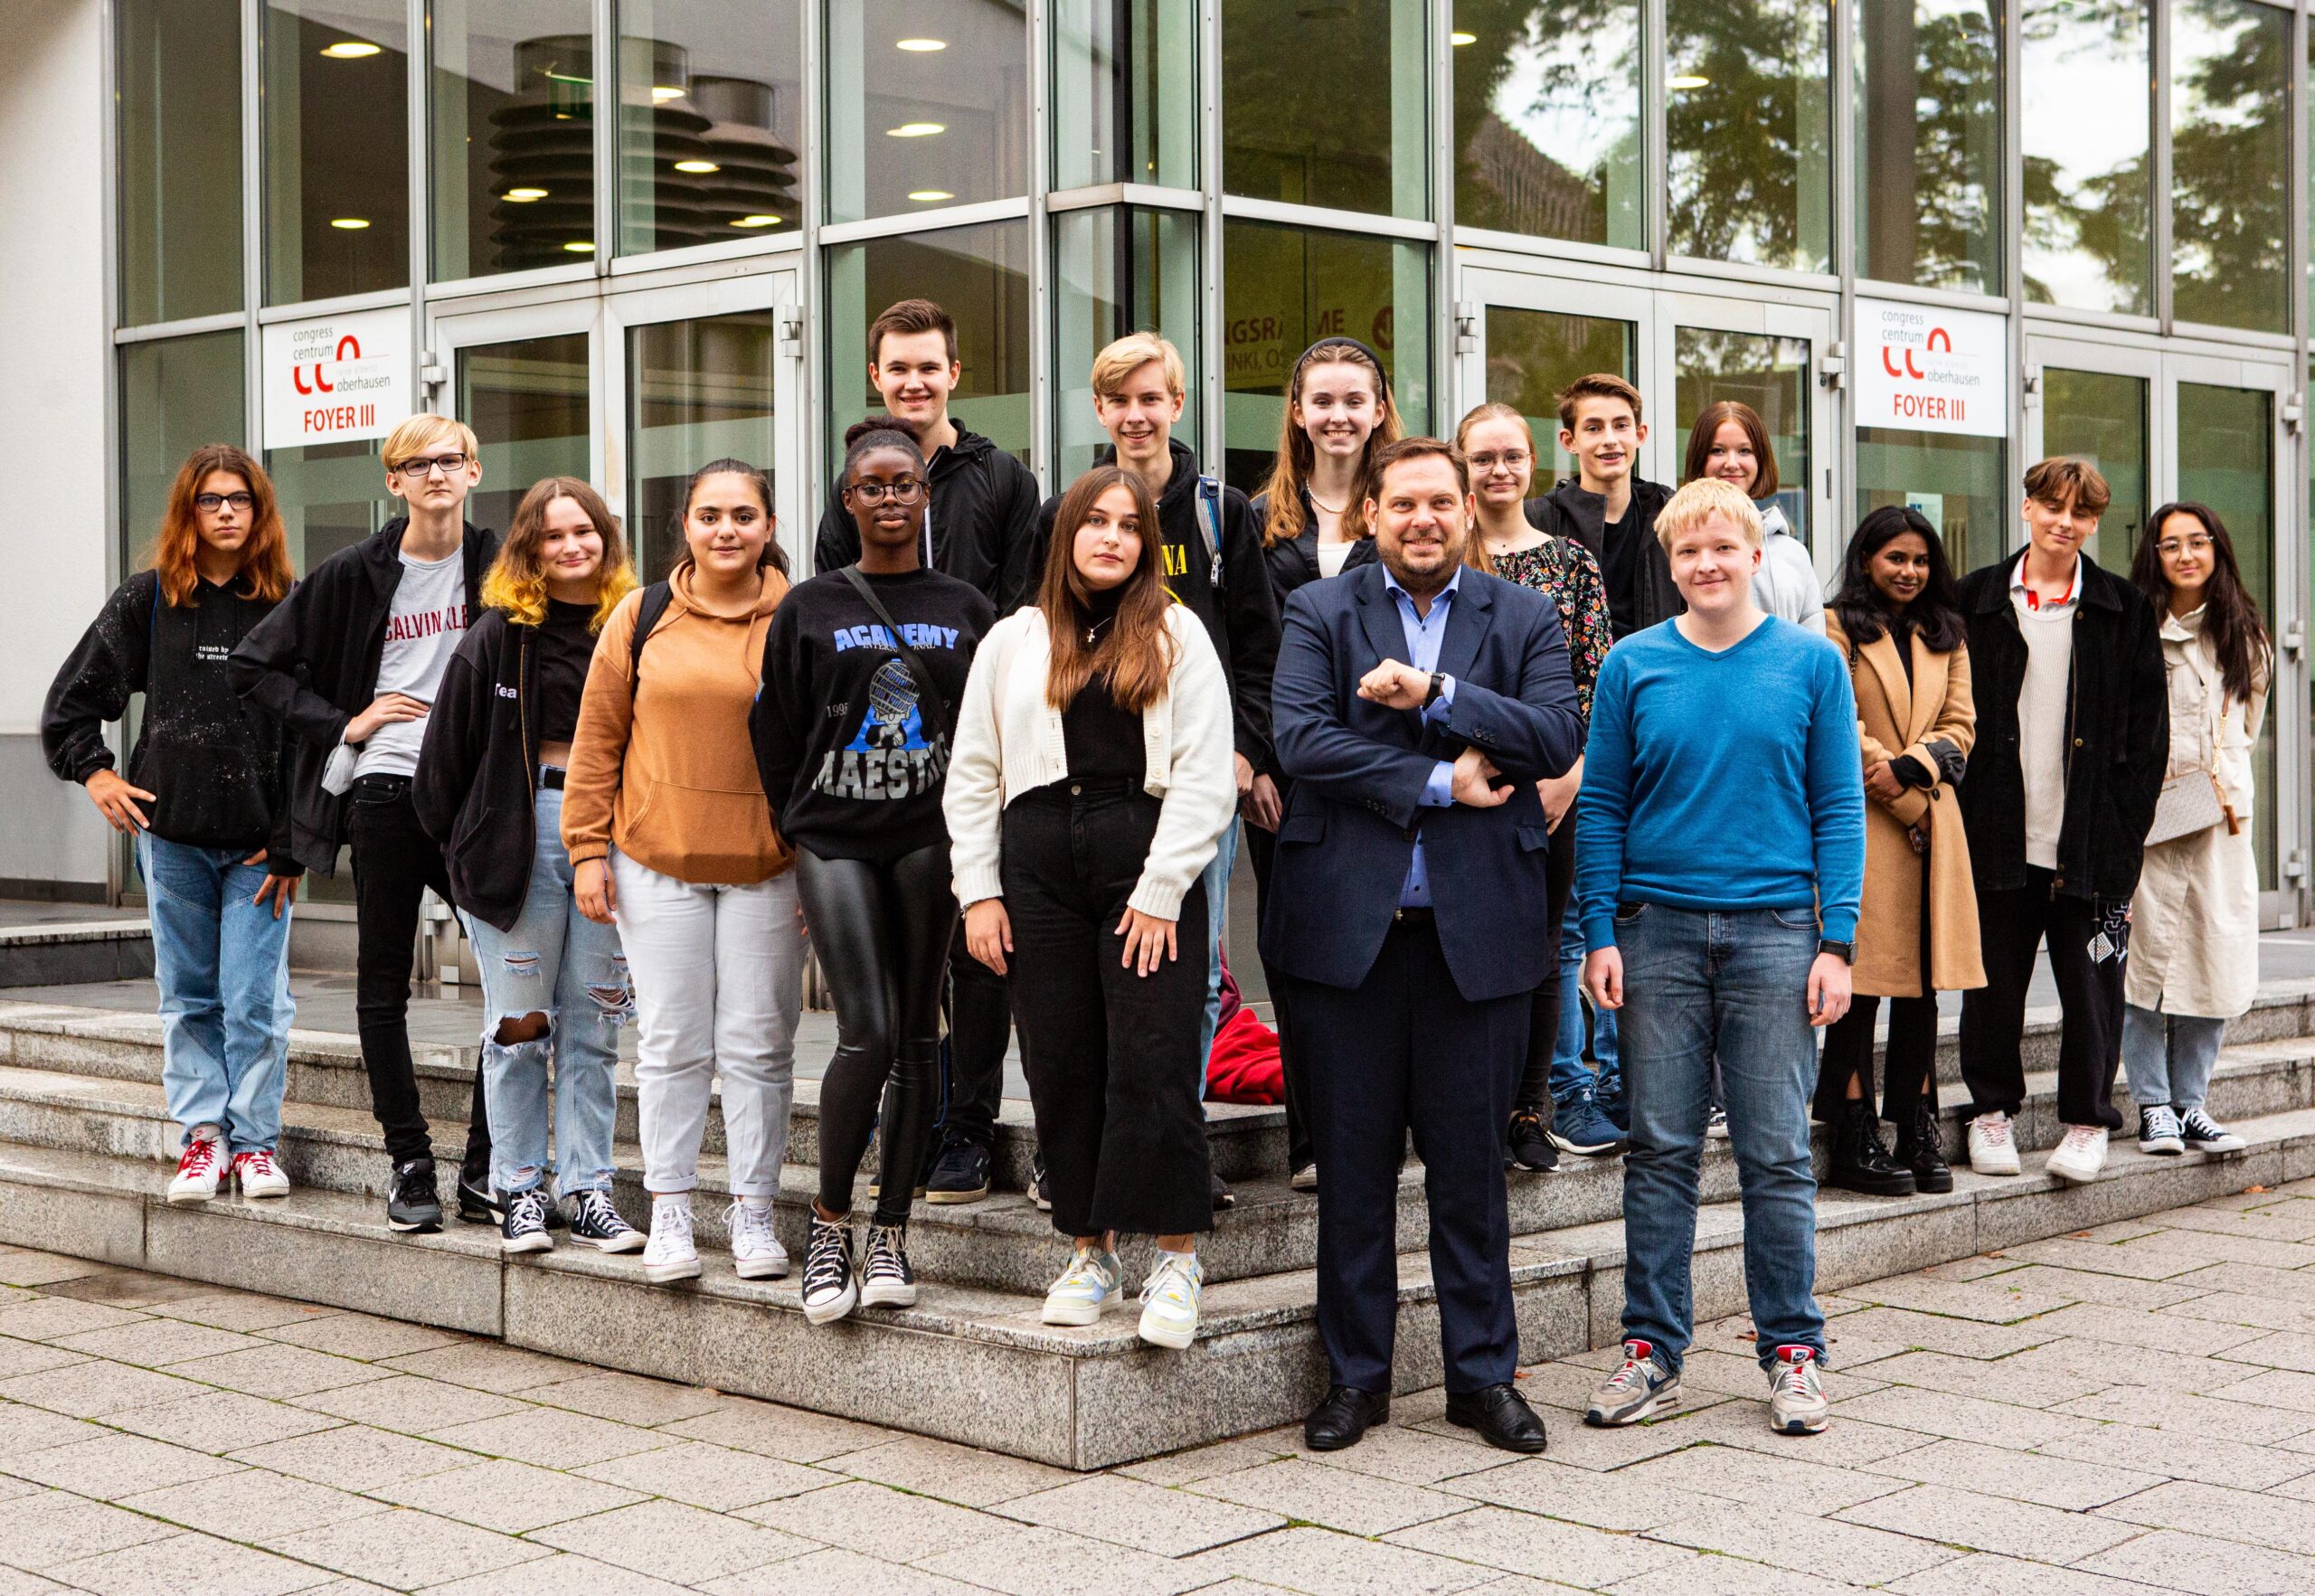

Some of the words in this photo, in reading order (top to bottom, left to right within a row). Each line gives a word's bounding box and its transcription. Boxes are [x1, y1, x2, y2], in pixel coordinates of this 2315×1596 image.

[1882, 310, 1924, 326] congress
[293, 326, 334, 344] congress
[1882, 328, 1924, 344] centrum
[293, 345, 334, 361] centrum
[336, 375, 391, 392] oberhausen
[1927, 369, 1980, 386] oberhausen
[1894, 393, 1946, 420] FOYER
[1951, 399, 1965, 421] III
[304, 406, 356, 433] FOYER
[360, 403, 374, 428] III
[221, 646, 230, 655] by
